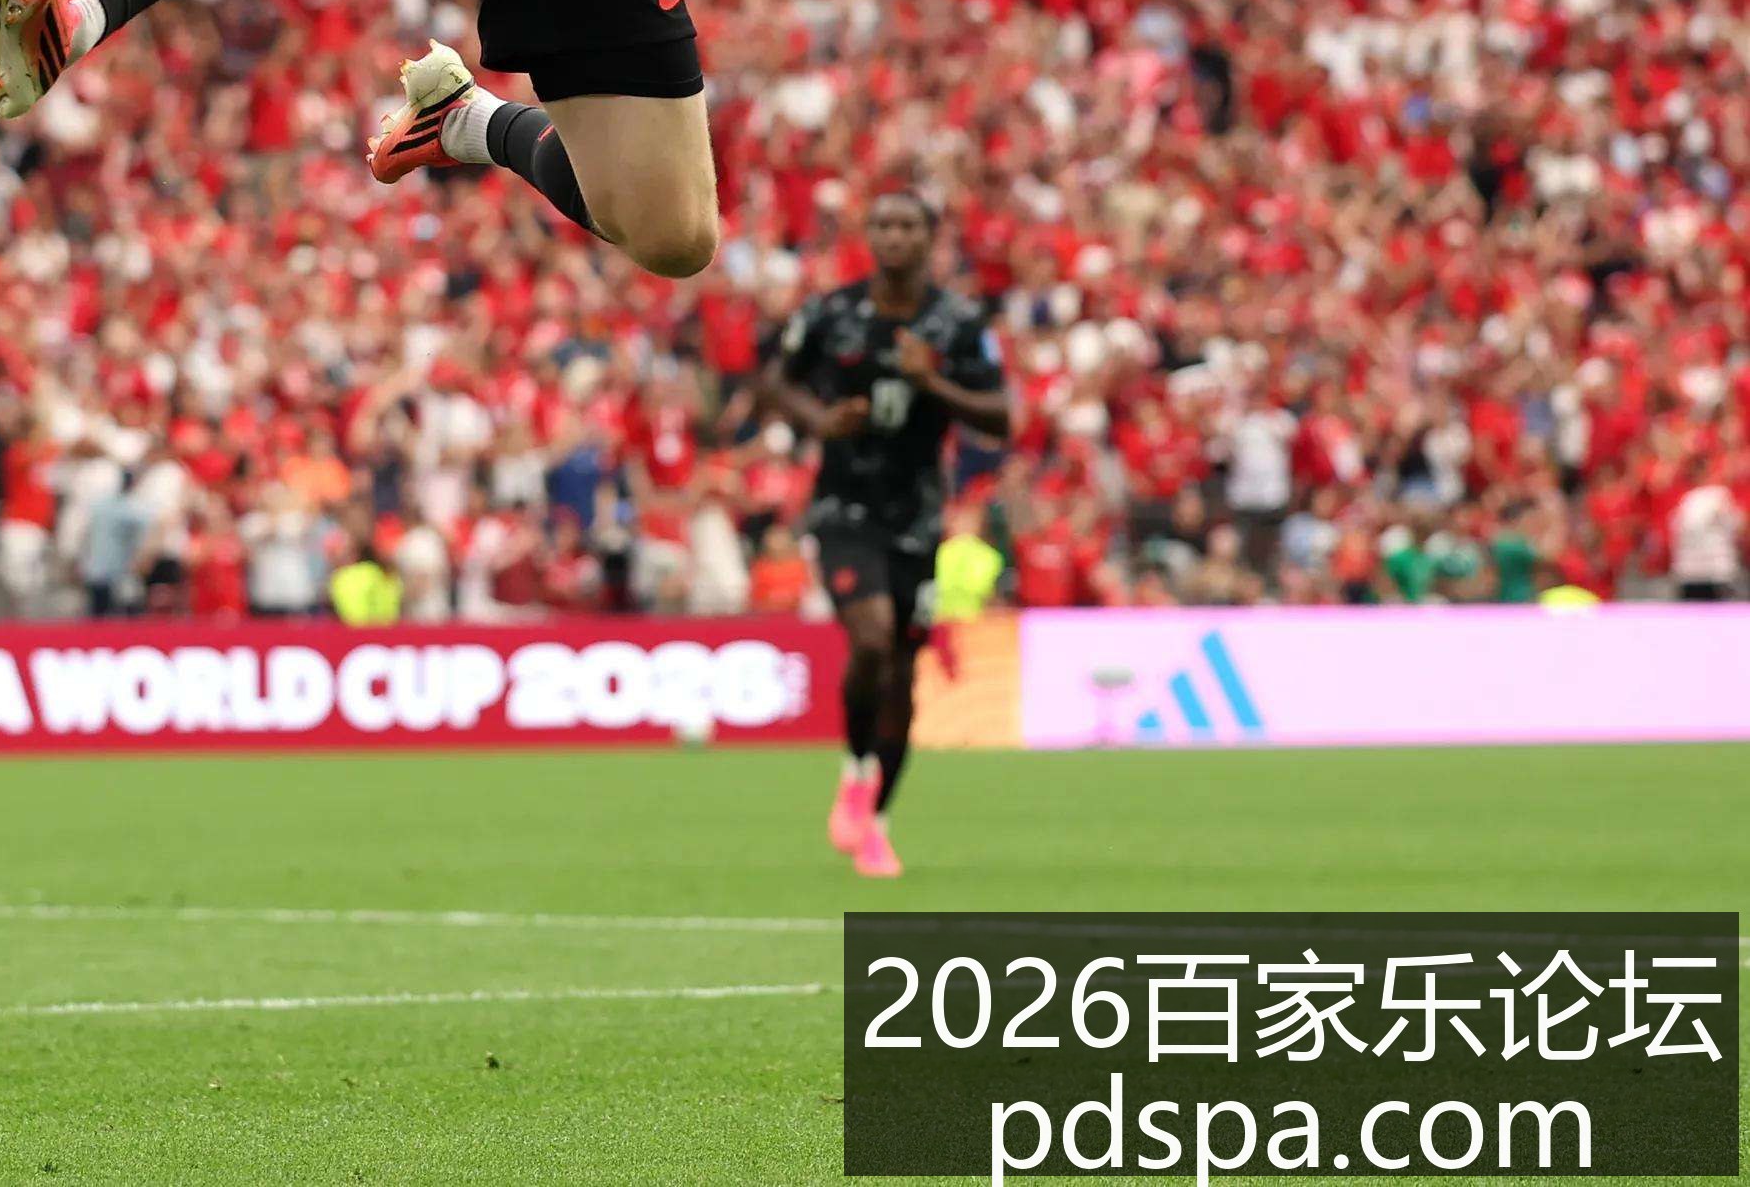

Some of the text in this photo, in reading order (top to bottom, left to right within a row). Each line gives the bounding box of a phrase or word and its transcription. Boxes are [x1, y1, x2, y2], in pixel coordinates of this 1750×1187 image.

[29, 645, 334, 733] WORLD
[337, 643, 504, 732] CUP
[506, 640, 787, 729] 2026
